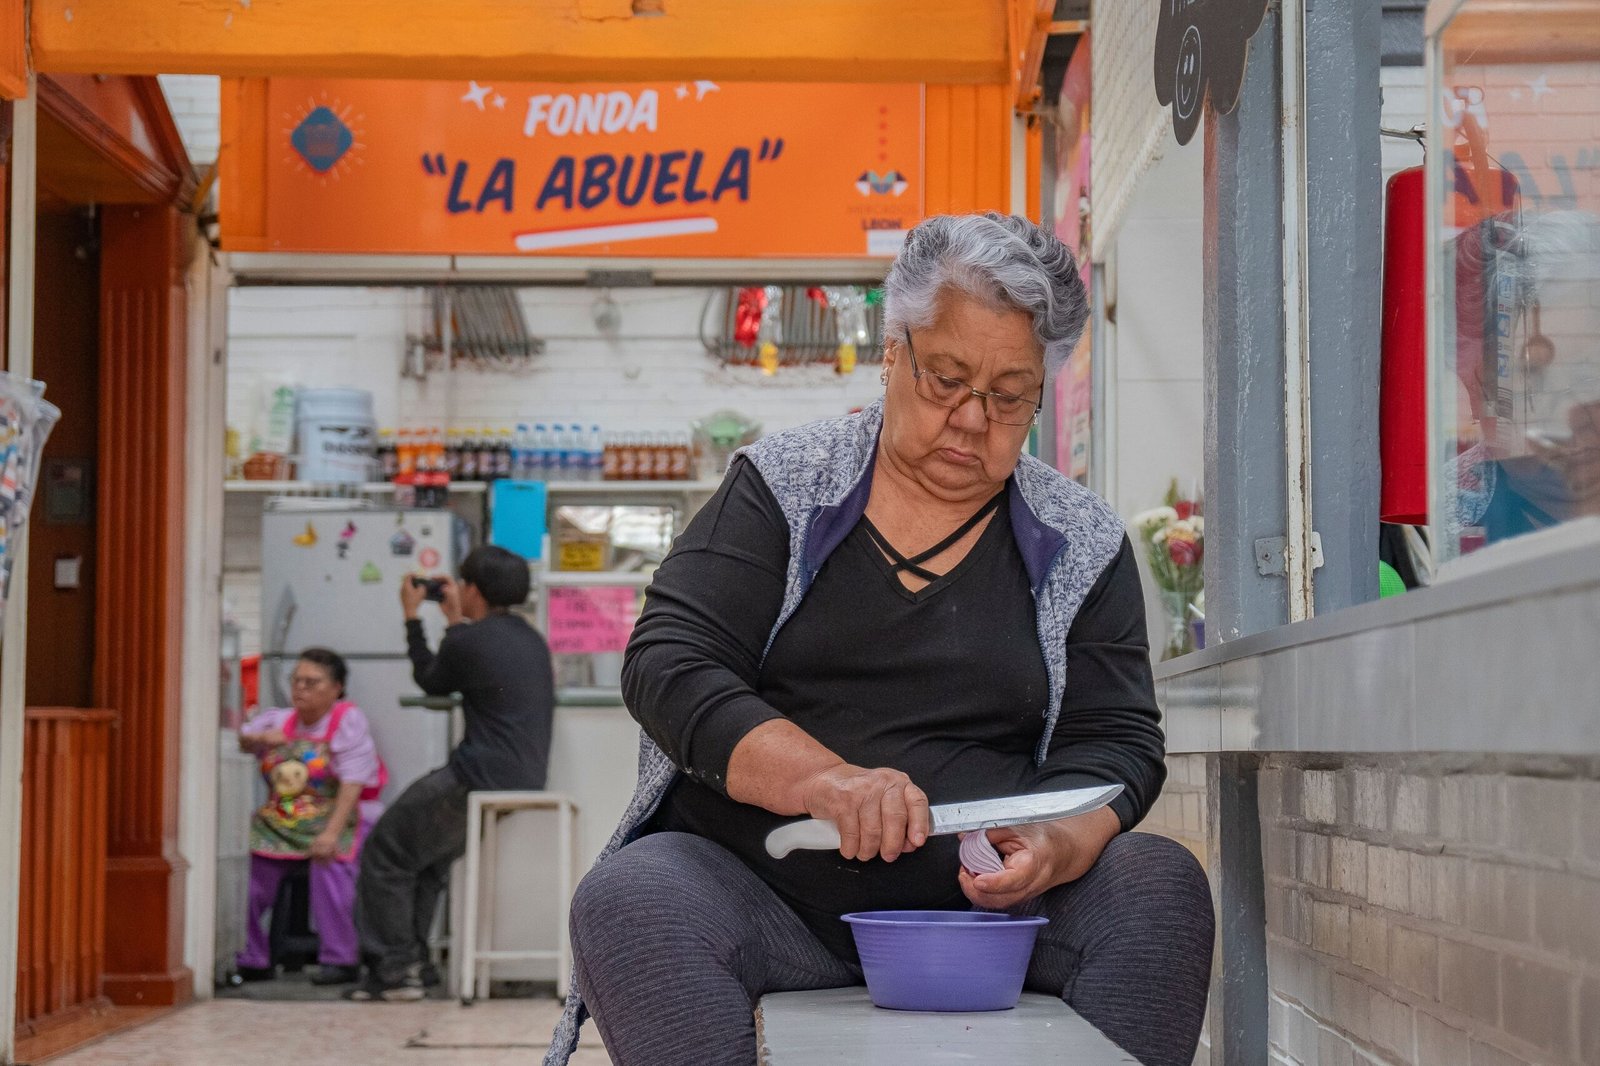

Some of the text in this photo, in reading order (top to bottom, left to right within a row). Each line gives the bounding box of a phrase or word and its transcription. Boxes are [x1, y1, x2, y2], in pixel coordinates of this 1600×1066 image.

[523, 90, 659, 137] FONDA
[420, 138, 785, 214] "LA ABUELA"
